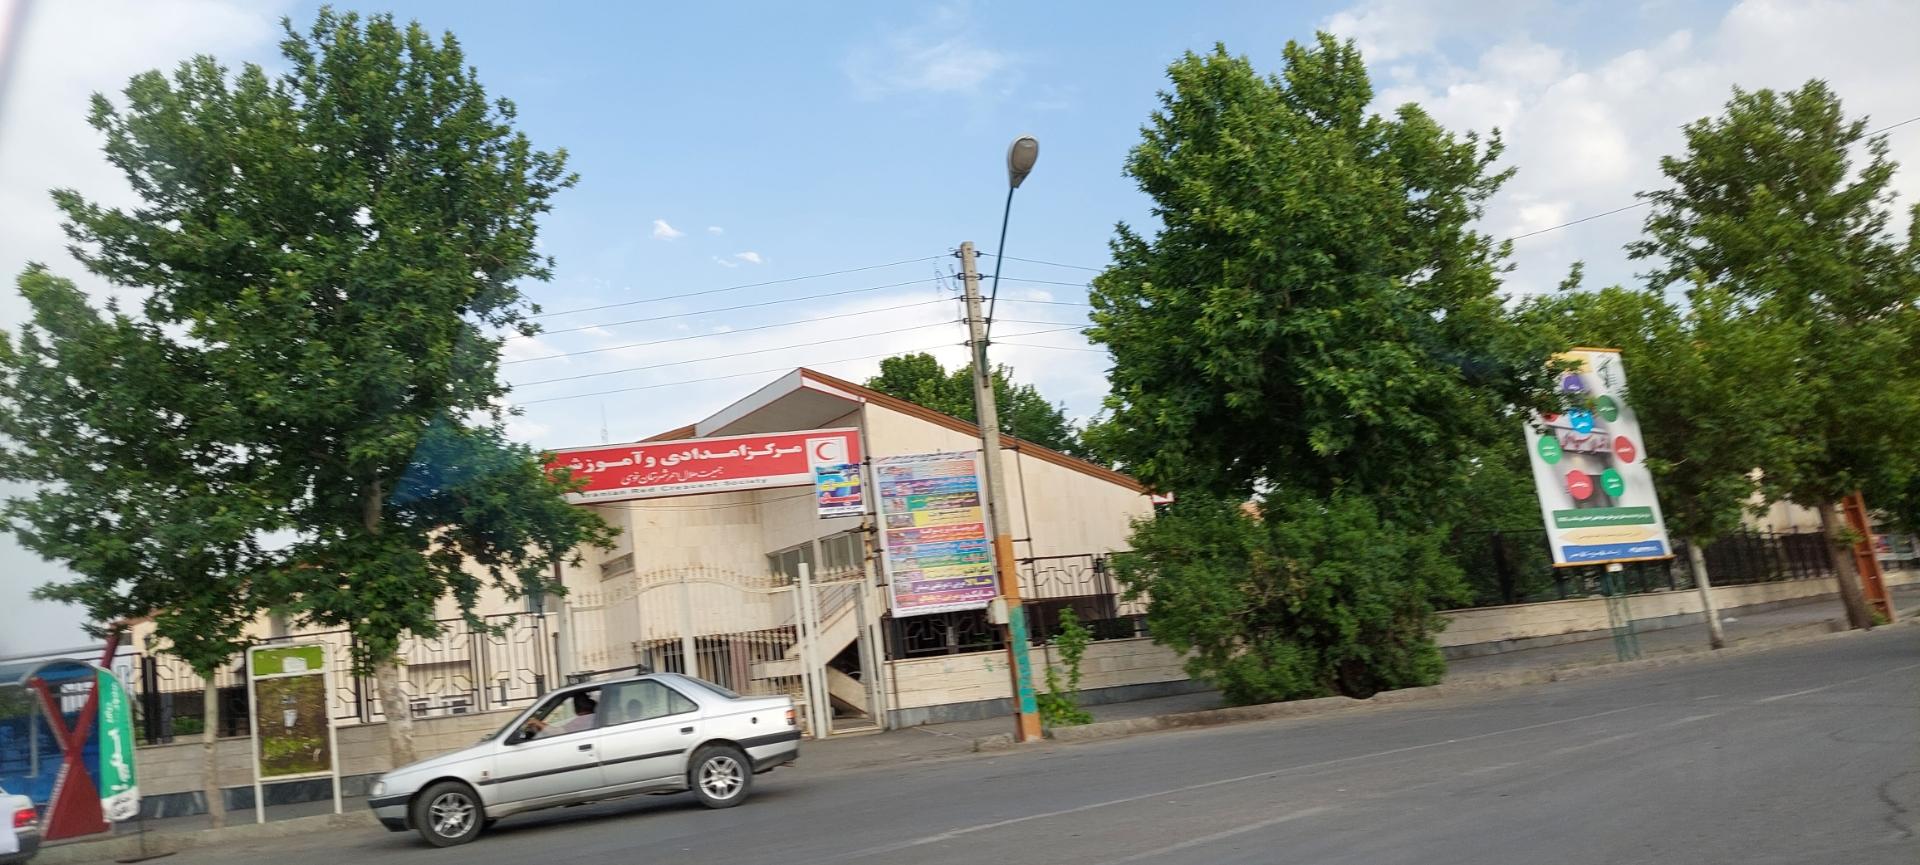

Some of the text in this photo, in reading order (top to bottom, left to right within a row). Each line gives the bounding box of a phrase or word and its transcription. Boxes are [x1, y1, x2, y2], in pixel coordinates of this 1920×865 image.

[660, 444, 748, 467] امدادی
[745, 443, 803, 461] مرکز
[645, 456, 658, 469] و
[660, 482, 718, 491] Crescent
[723, 477, 768, 487] Society
